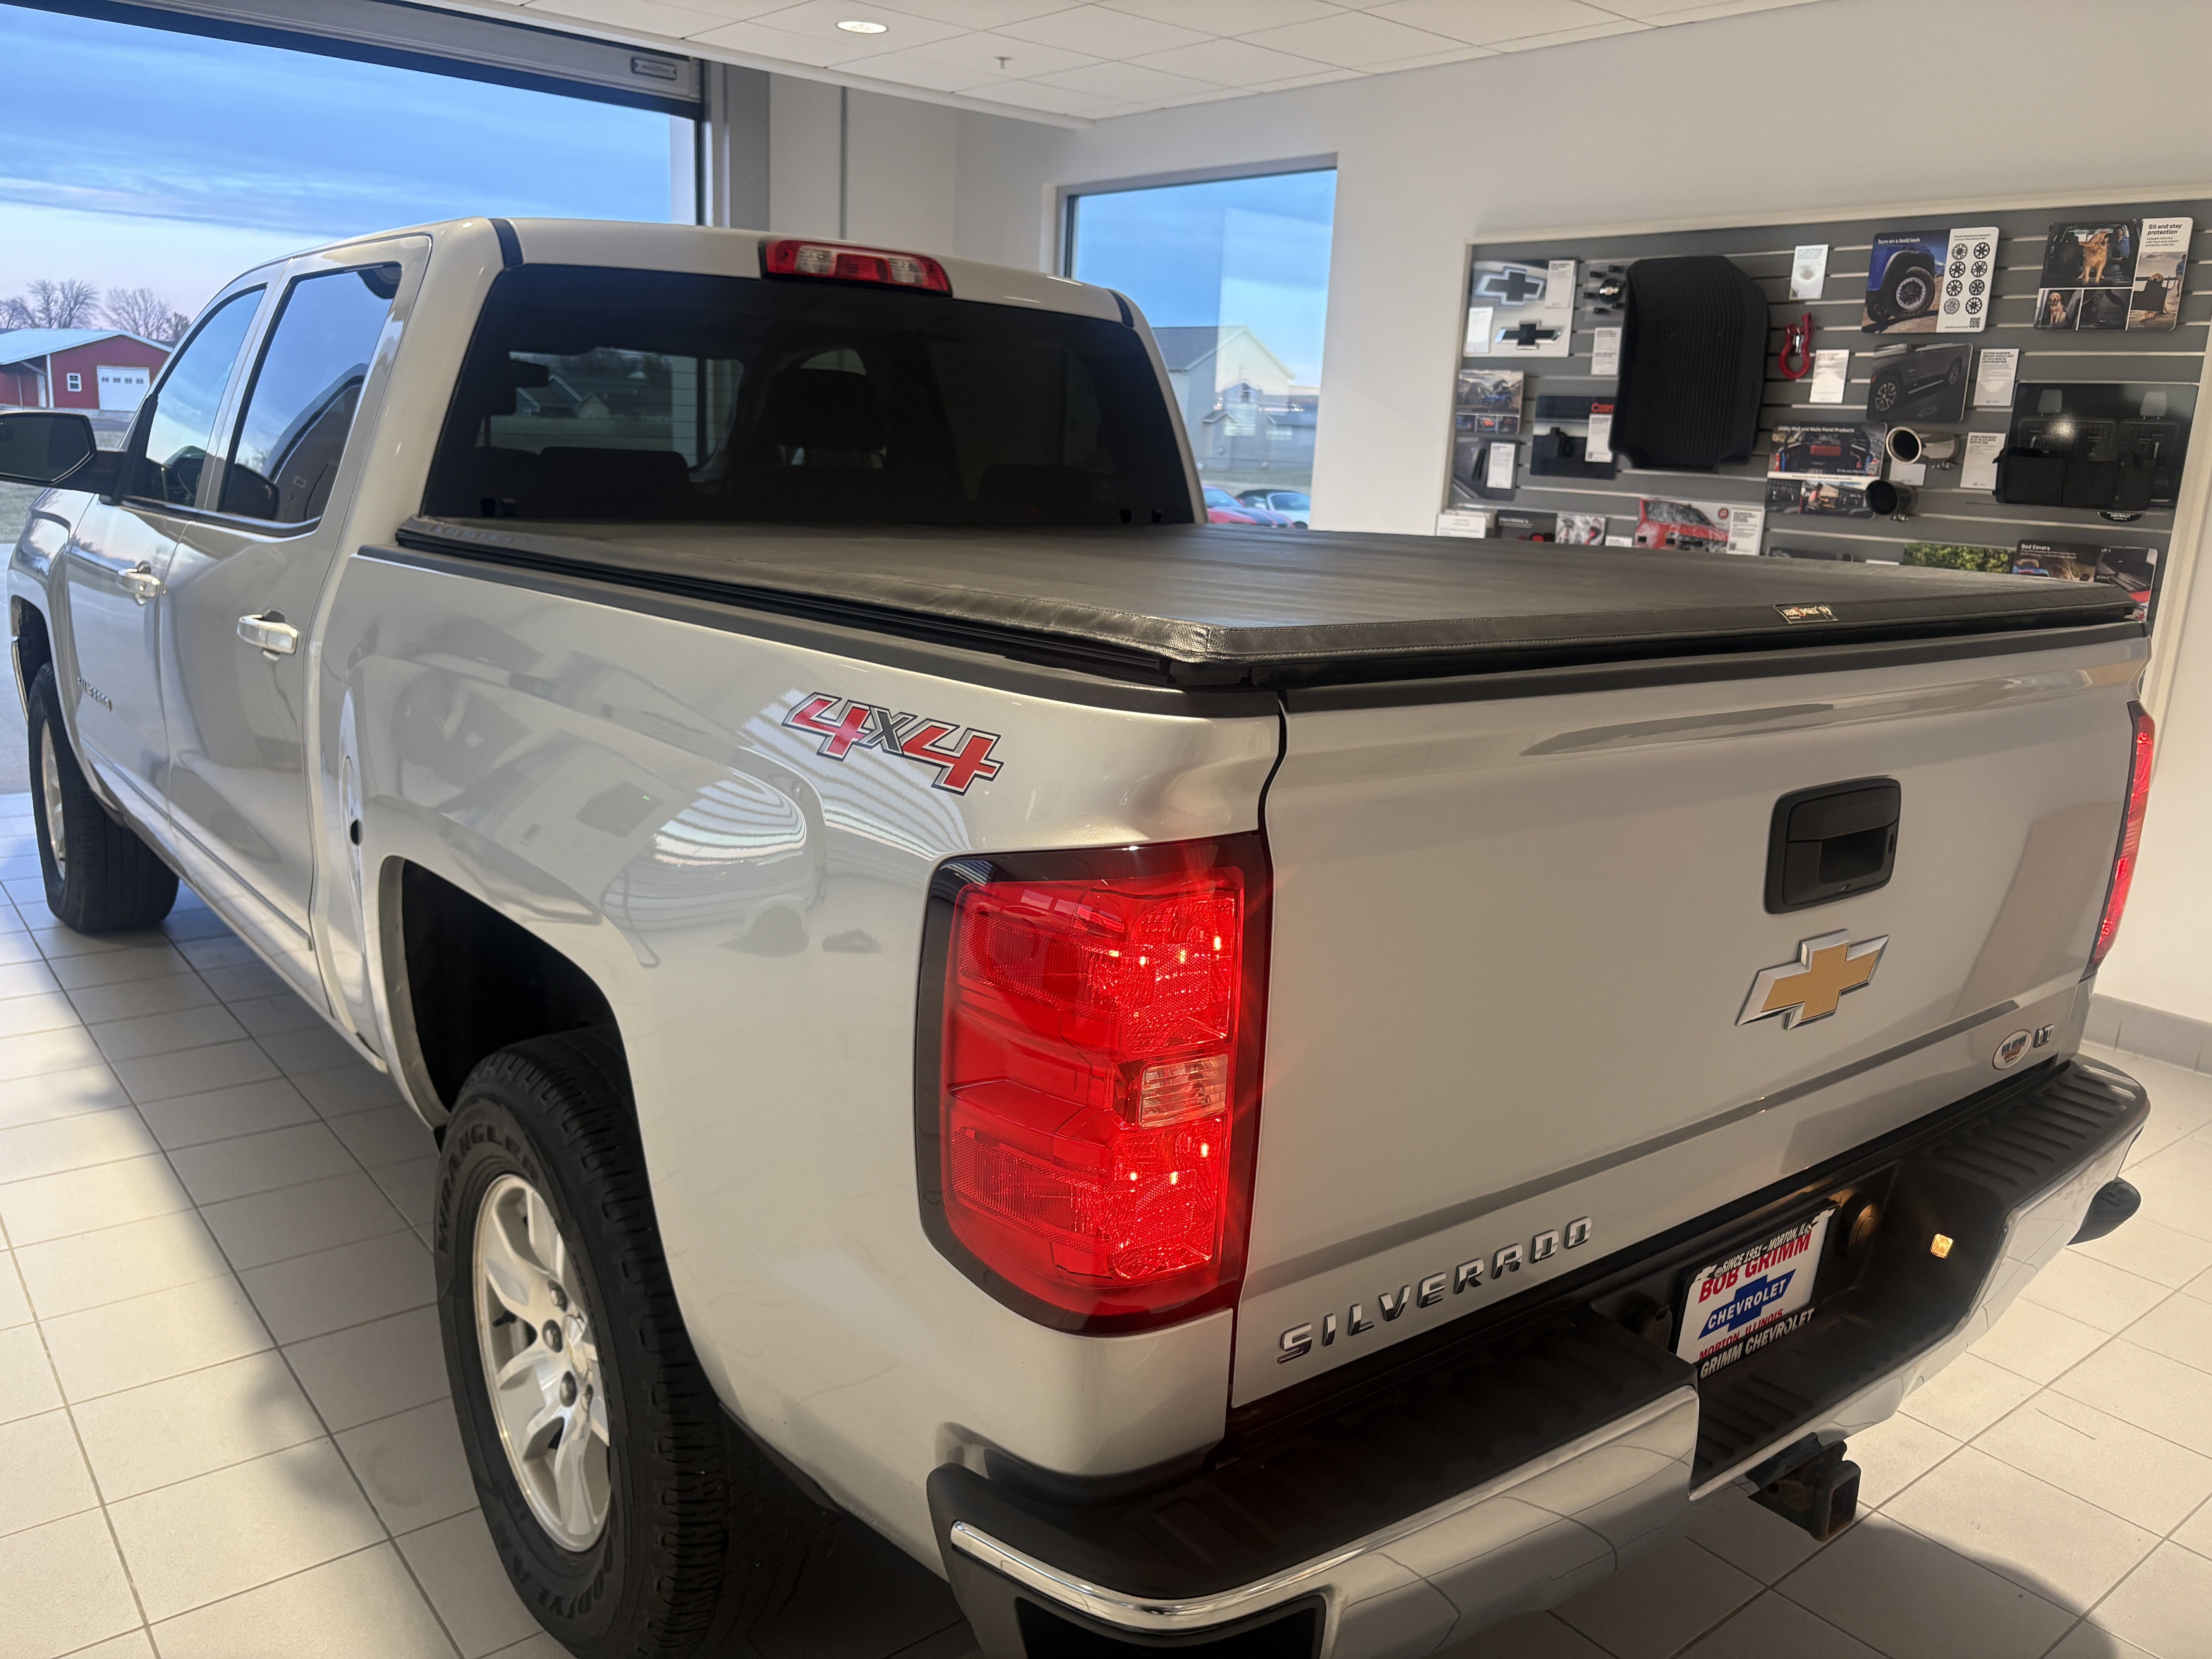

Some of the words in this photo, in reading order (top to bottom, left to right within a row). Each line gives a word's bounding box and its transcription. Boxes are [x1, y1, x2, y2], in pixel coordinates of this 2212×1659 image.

[438, 1123, 539, 1254] WRANGLER
[1278, 1216, 1592, 1364] SILVERADO
[1698, 1266, 1740, 1304] BOB
[1745, 1230, 1812, 1278] GRIMM
[1723, 1252, 1746, 1274] SINCE
[1744, 1244, 1763, 1262] 1951
[1708, 1279, 1786, 1330] CHEVROLET
[1745, 1308, 1783, 1335] ILLINOIS
[1700, 1341, 1744, 1380] GRIMM
[1745, 1307, 1814, 1355] CHEVROLET
